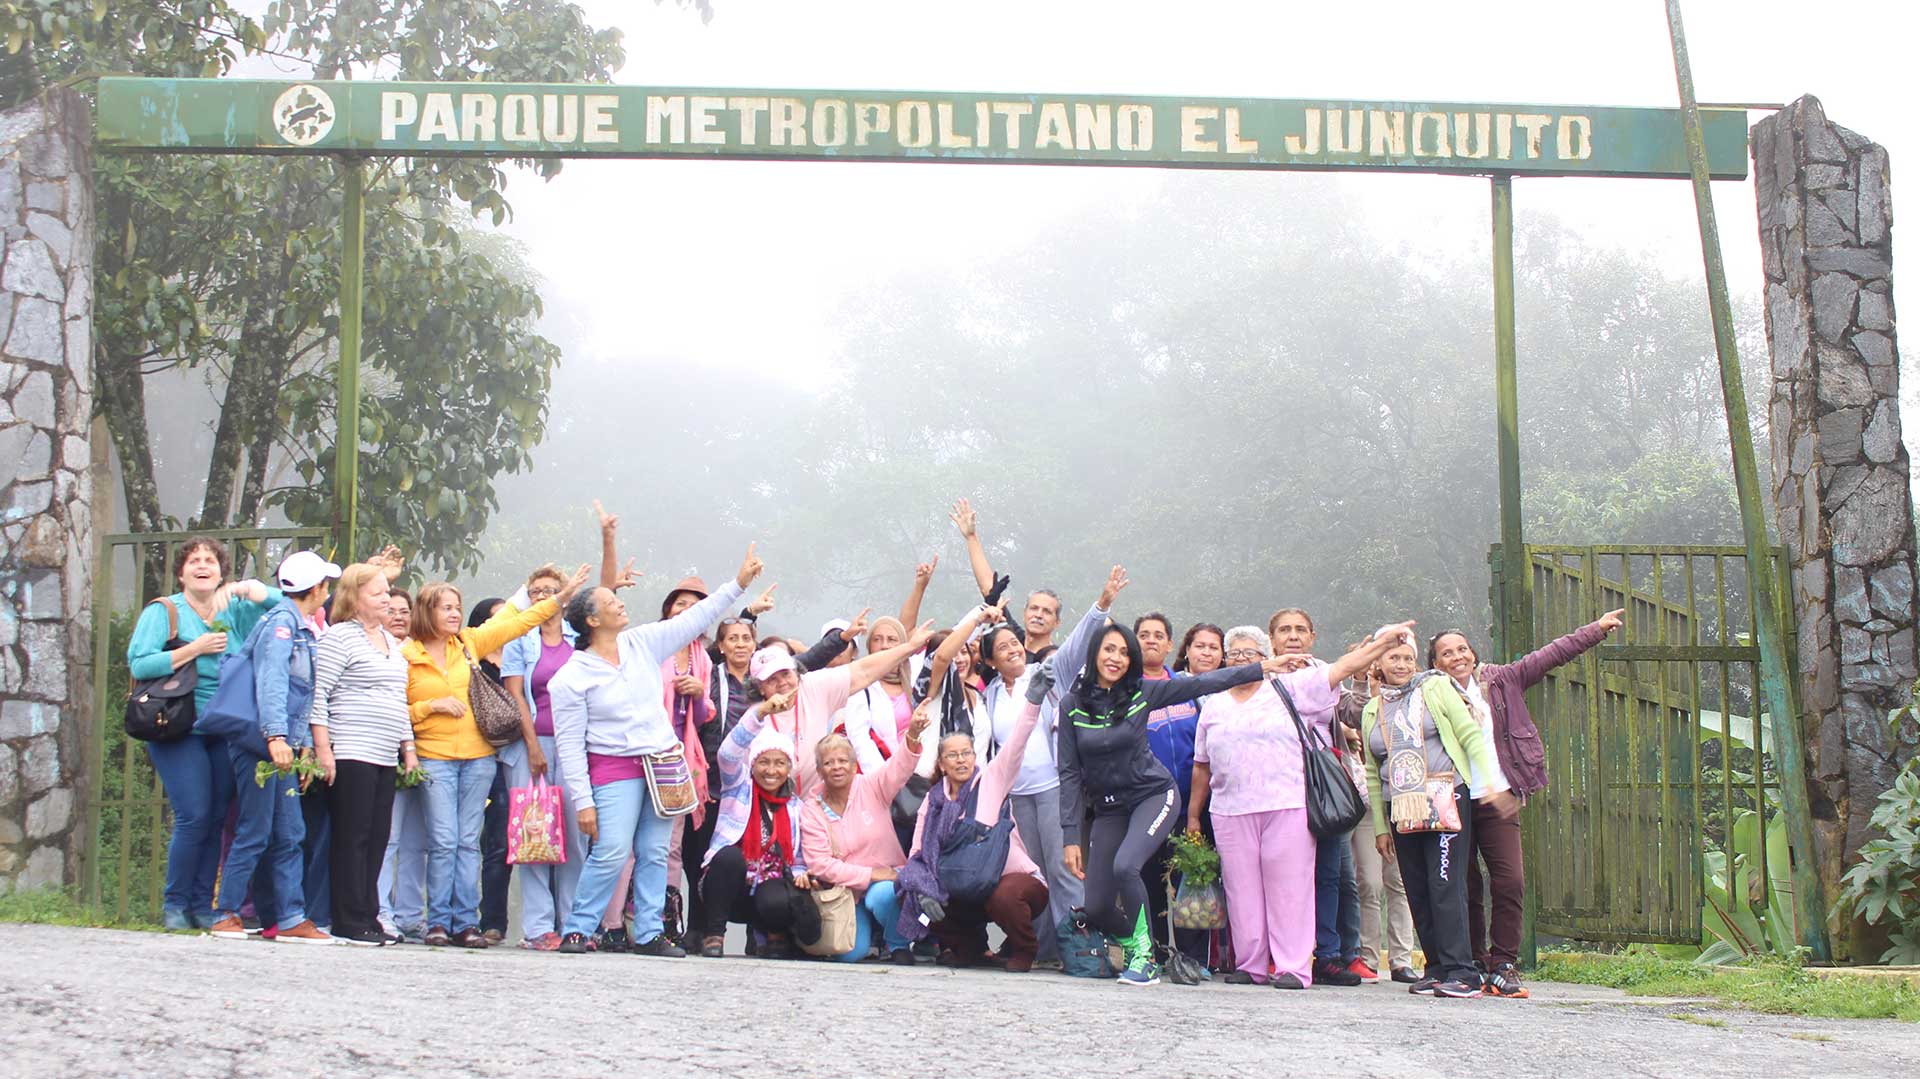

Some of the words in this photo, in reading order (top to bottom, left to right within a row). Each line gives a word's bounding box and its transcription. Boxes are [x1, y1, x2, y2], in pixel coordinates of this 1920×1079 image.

[381, 91, 619, 144] PARQUE
[646, 95, 1153, 151] METROPOLITANO
[1180, 105, 1258, 154] EL
[1285, 108, 1592, 161] JUNQUITO
